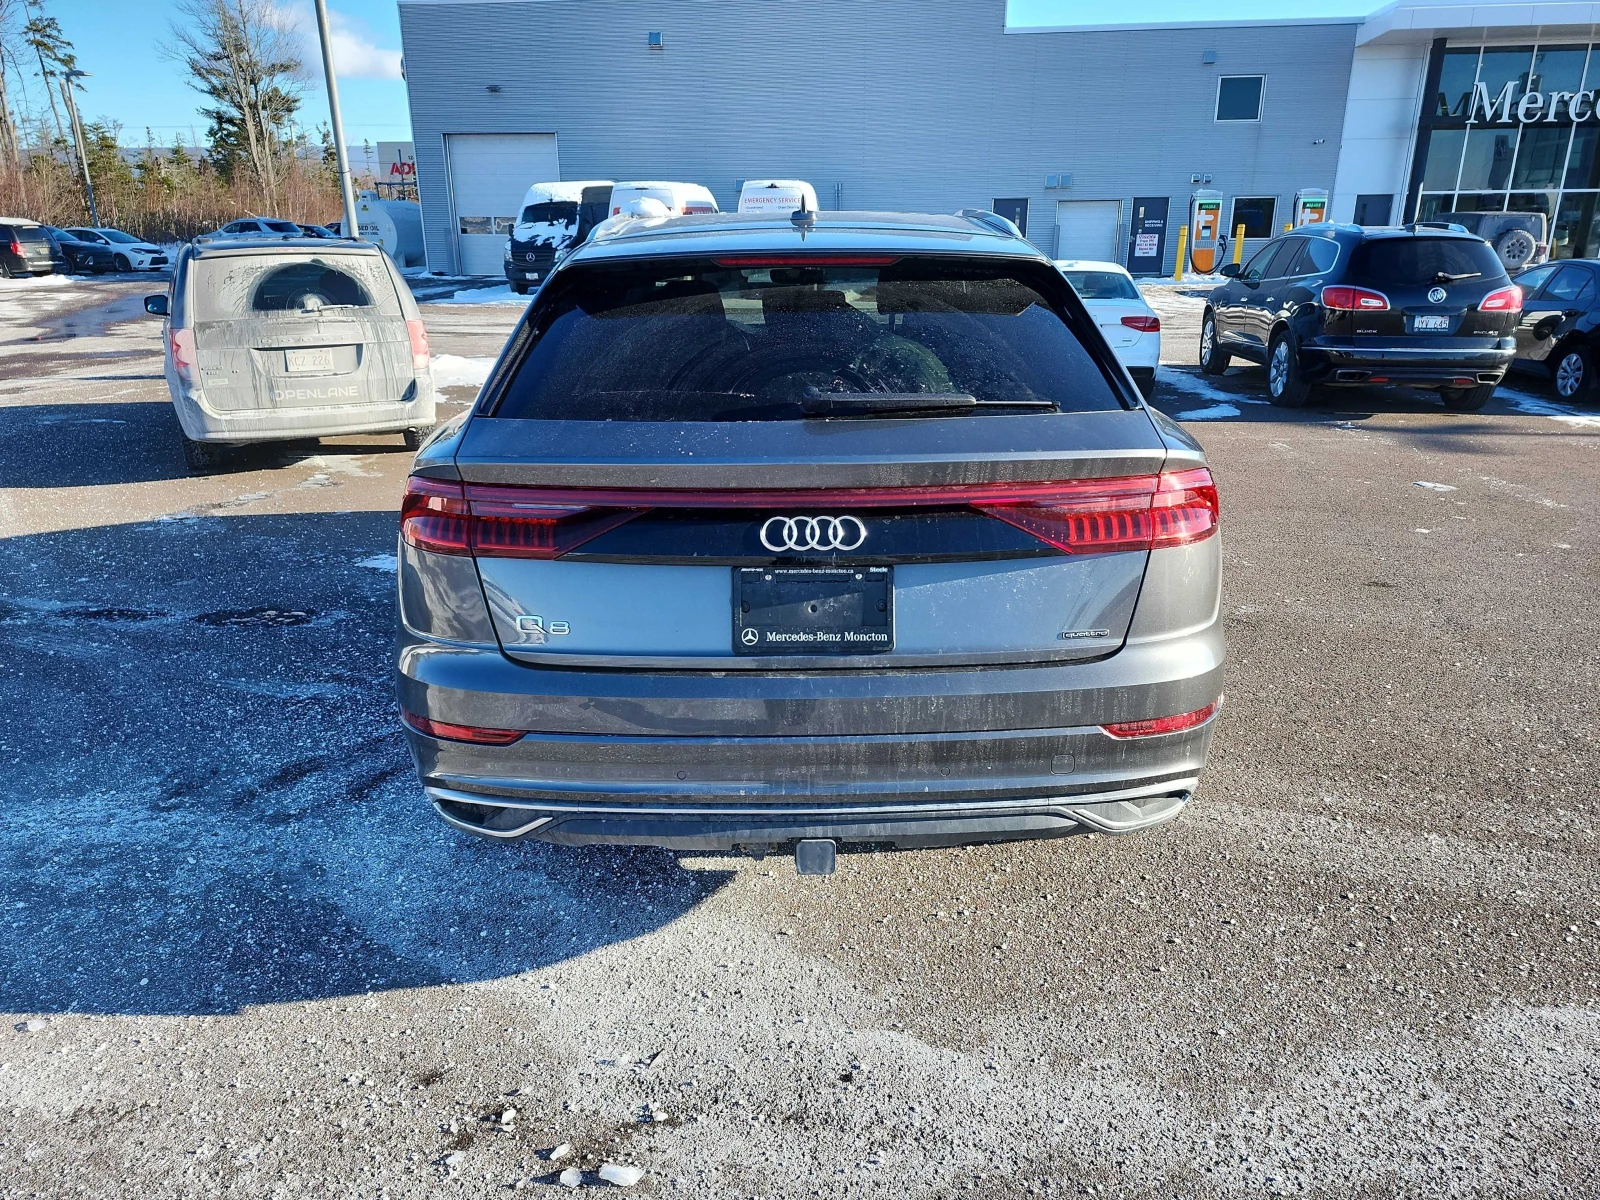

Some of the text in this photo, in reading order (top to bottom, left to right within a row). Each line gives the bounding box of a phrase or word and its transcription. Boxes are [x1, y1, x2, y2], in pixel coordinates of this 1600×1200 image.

[1464, 81, 1600, 124] Merc
[1433, 319, 1448, 328] 645
[287, 354, 331, 367] KCZ 226
[274, 386, 359, 400] OPENLANE
[766, 631, 888, 642] Mercedes-Benz Moncton
[1065, 631, 1108, 639] quattro
